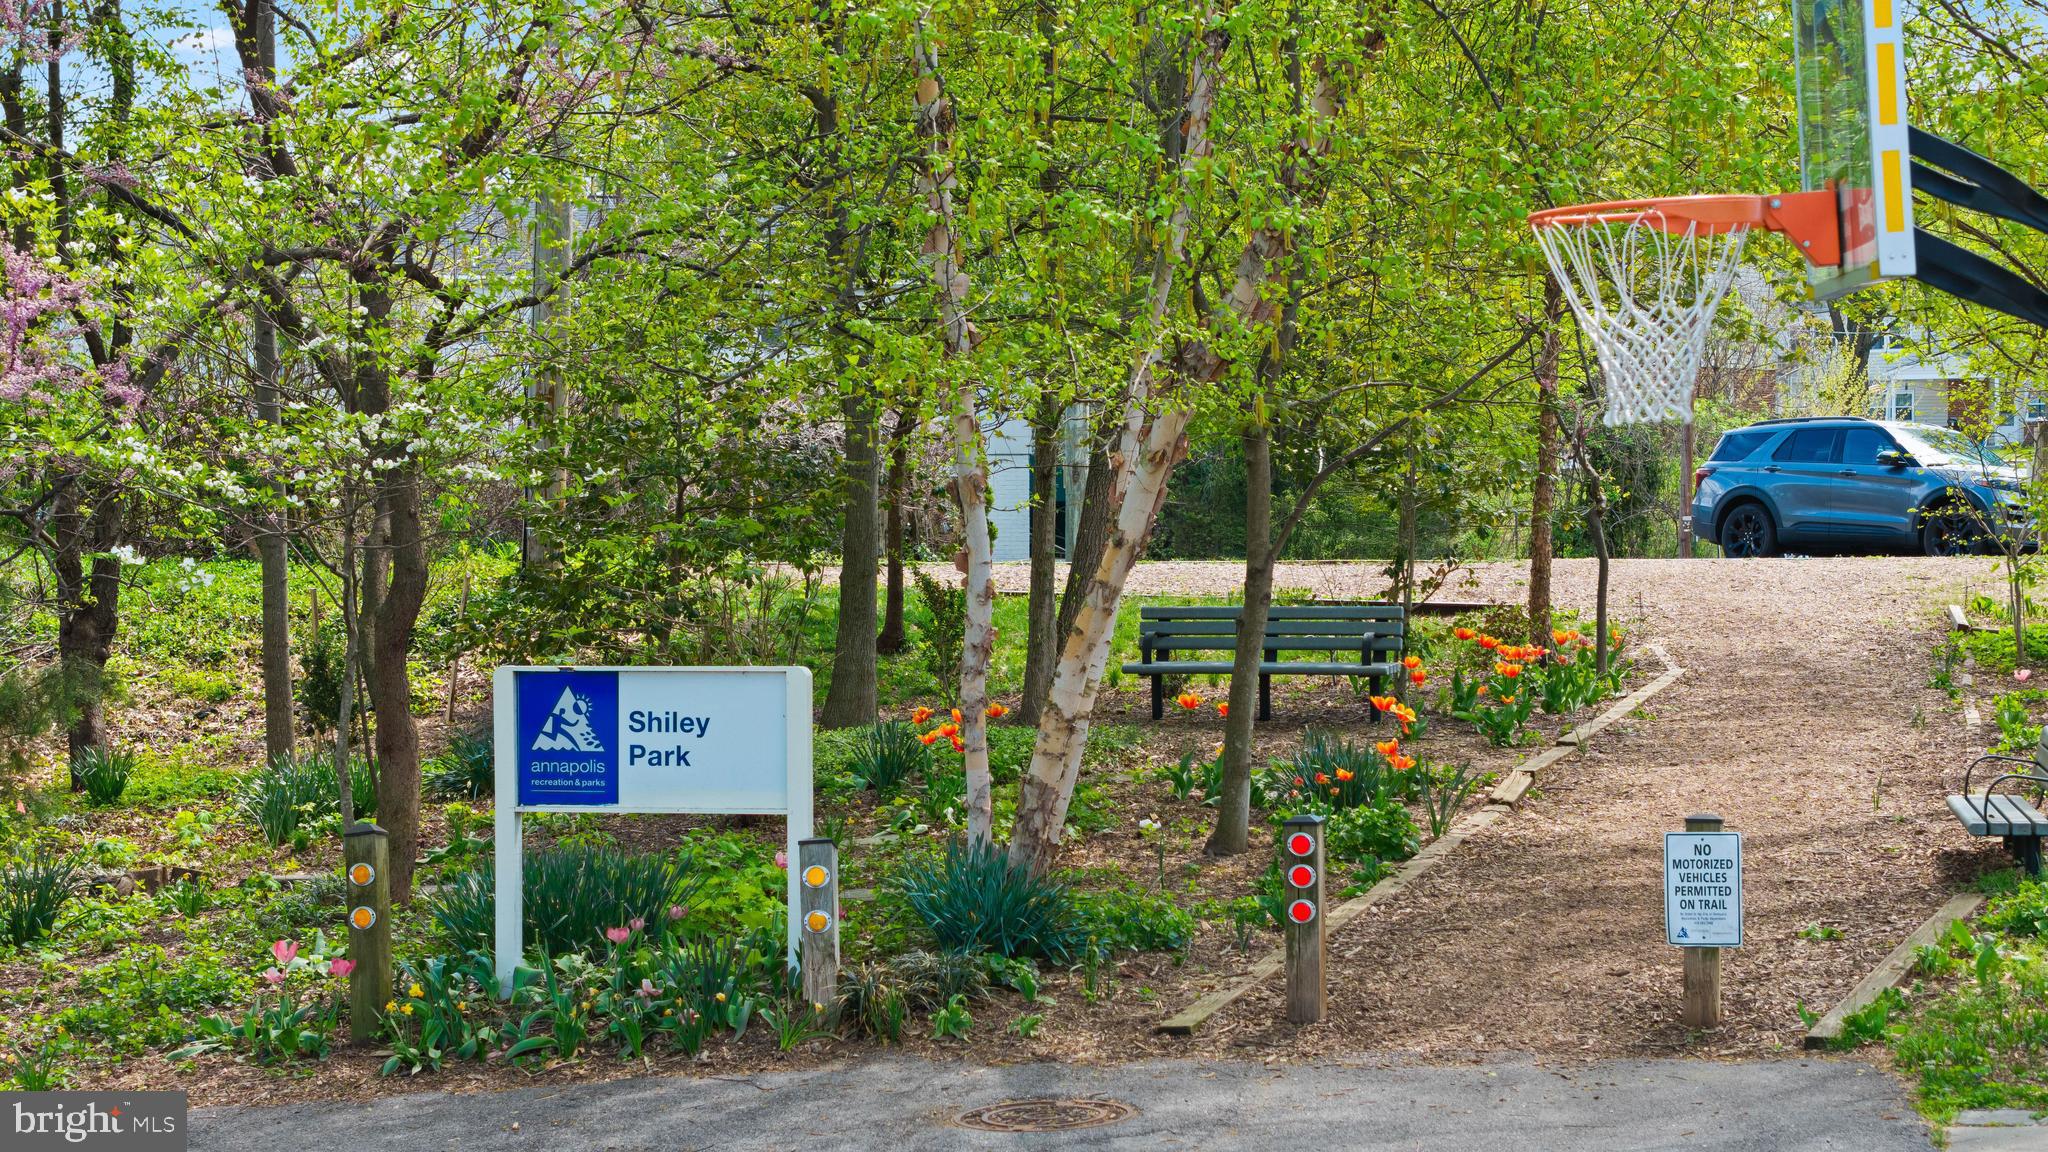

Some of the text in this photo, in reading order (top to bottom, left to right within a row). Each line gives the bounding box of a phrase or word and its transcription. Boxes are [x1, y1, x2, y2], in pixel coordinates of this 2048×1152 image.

[628, 710, 711, 738] Shiley
[629, 744, 691, 767] Park
[531, 759, 605, 776] annapolis
[581, 779, 605, 787] parks
[1694, 844, 1711, 856] NO
[1672, 859, 1733, 870] MOTORIZED
[1679, 872, 1727, 883] VEHICLES
[1674, 886, 1732, 897] PERMITTED
[1680, 899, 1727, 910] ON TRAIL
